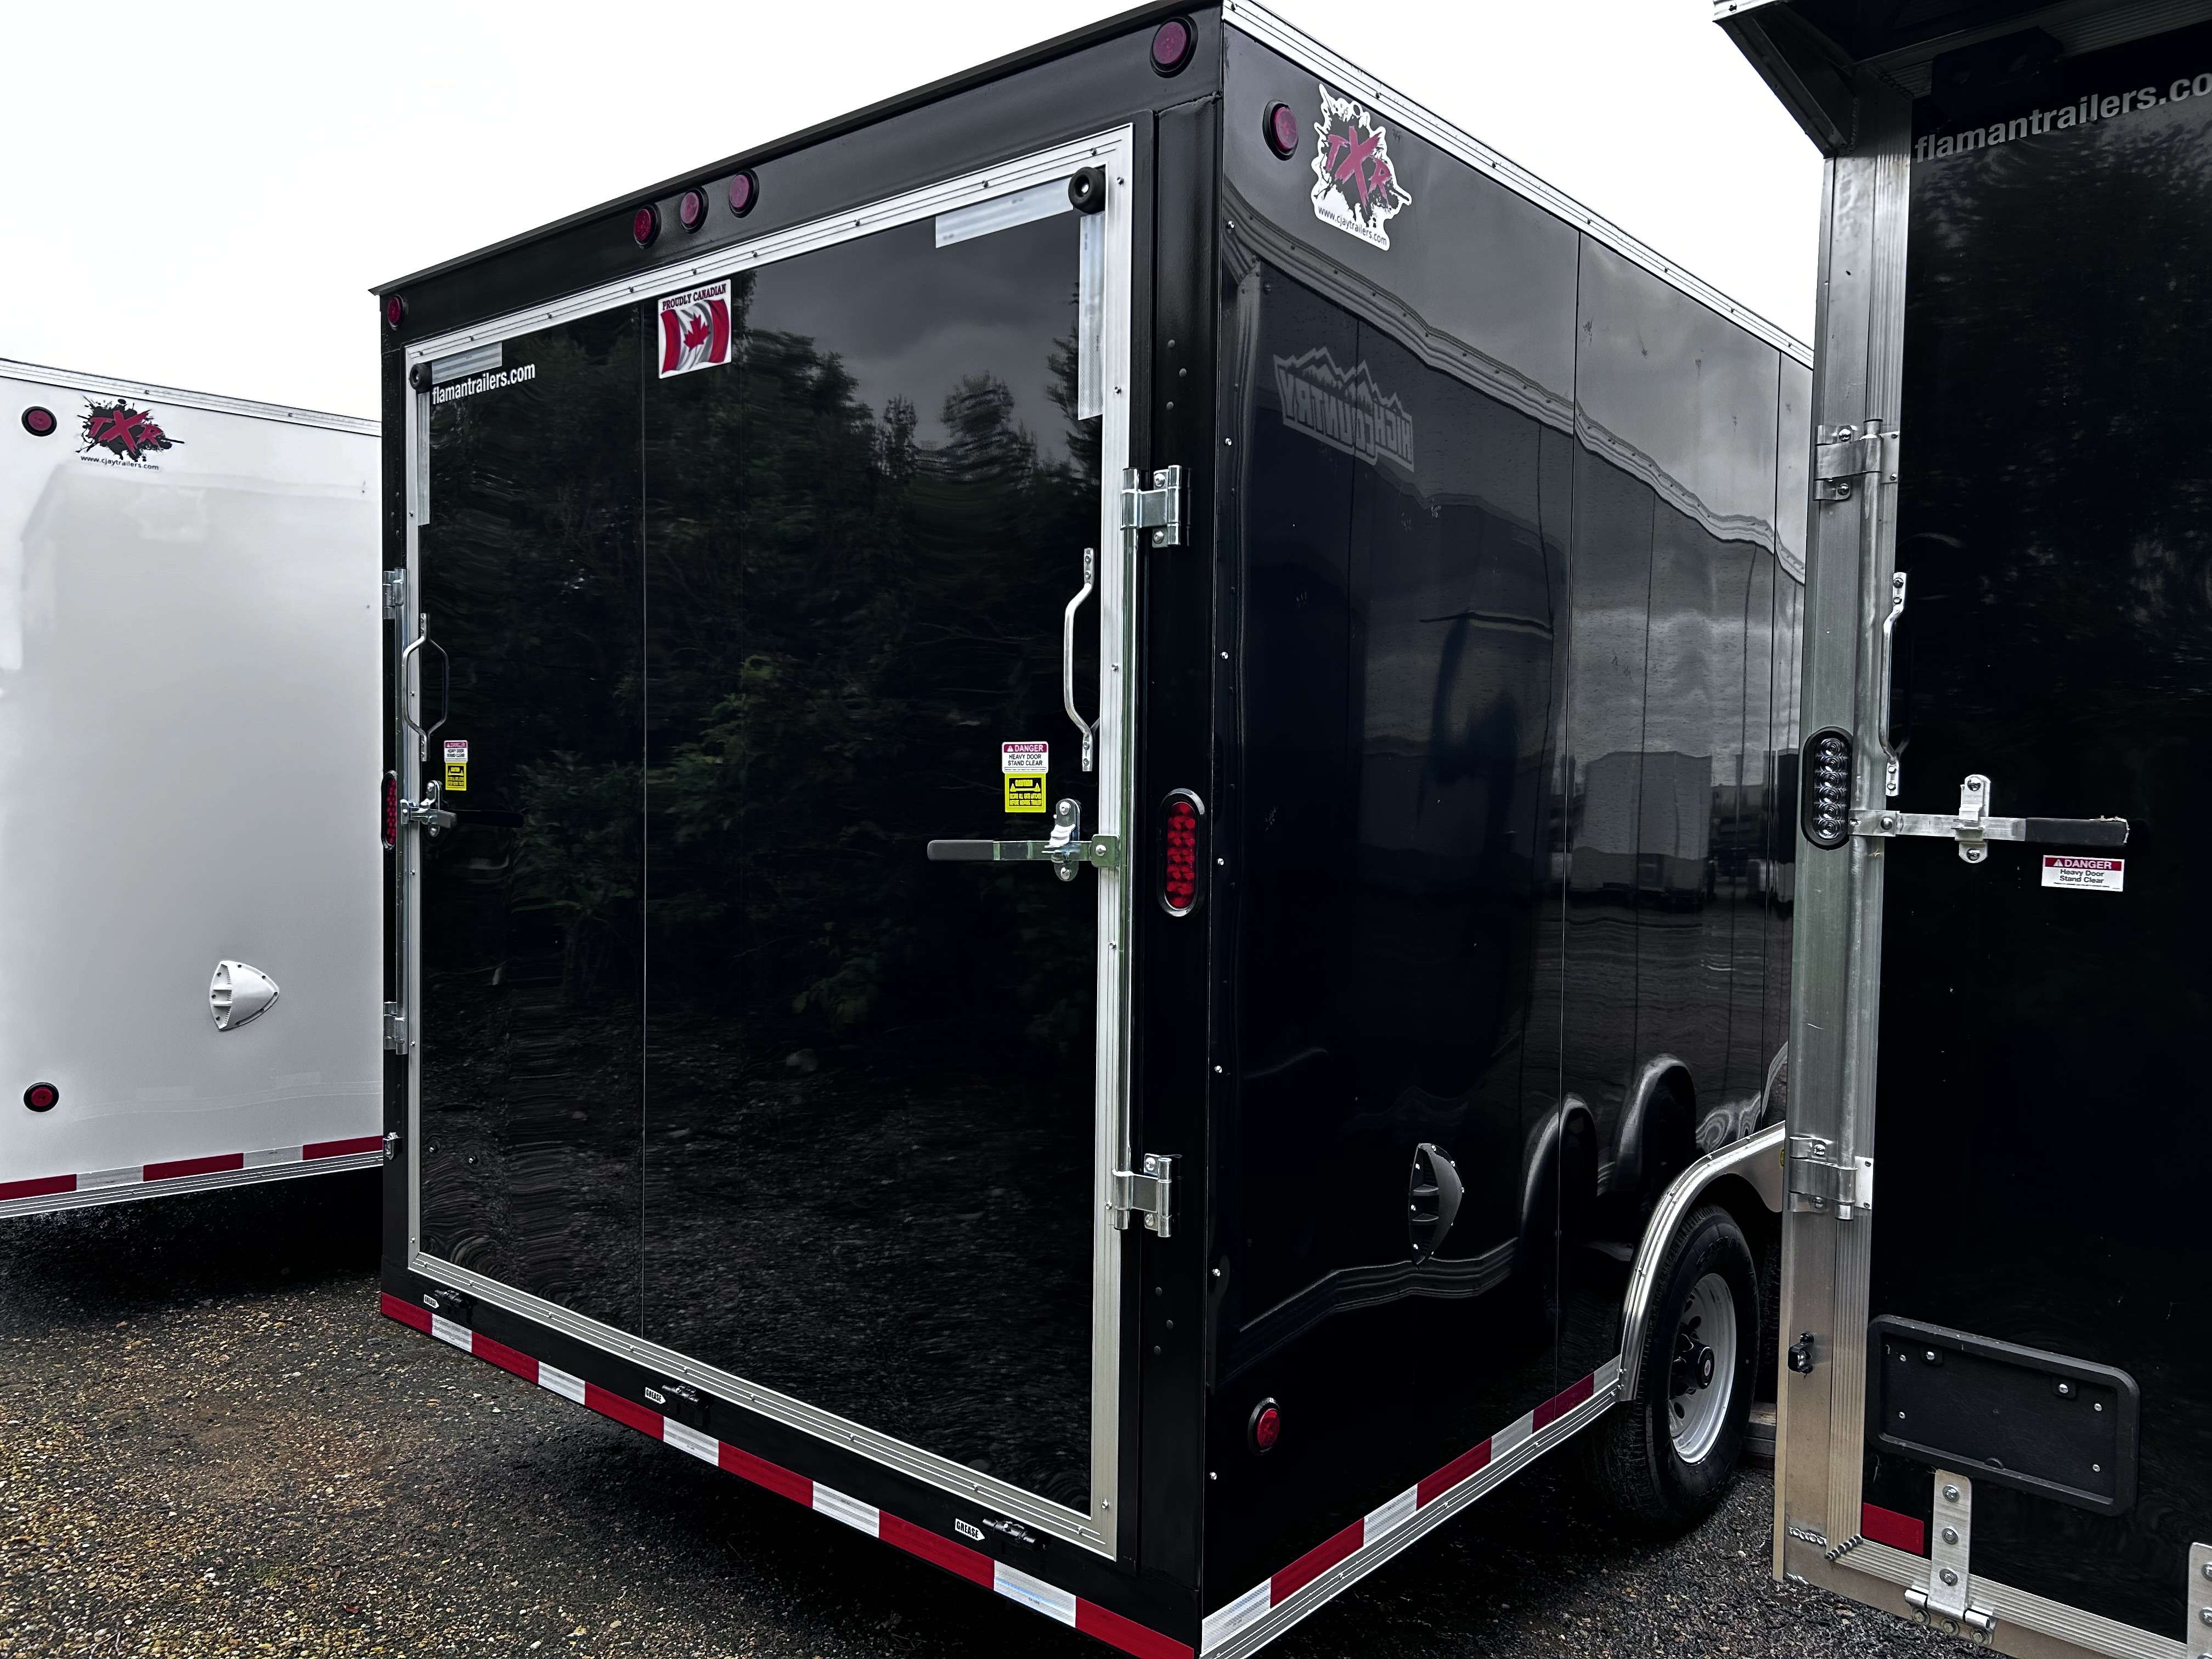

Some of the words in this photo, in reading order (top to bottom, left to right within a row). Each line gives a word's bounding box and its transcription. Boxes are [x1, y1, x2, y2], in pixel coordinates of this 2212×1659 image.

[1324, 126, 1392, 215] TXR
[1317, 205, 1387, 246] www.cjaytrailers.com
[662, 294, 692, 311] PROUDLY
[693, 283, 726, 301] CANADIAN
[432, 363, 535, 404] flamantrailers.com
[88, 409, 164, 456] TXR
[80, 455, 159, 470] www.cjaytrailers.com
[2064, 859, 2112, 870] DANGER
[646, 1389, 662, 1403] GREASE
[956, 1521, 979, 1539] GREASE
